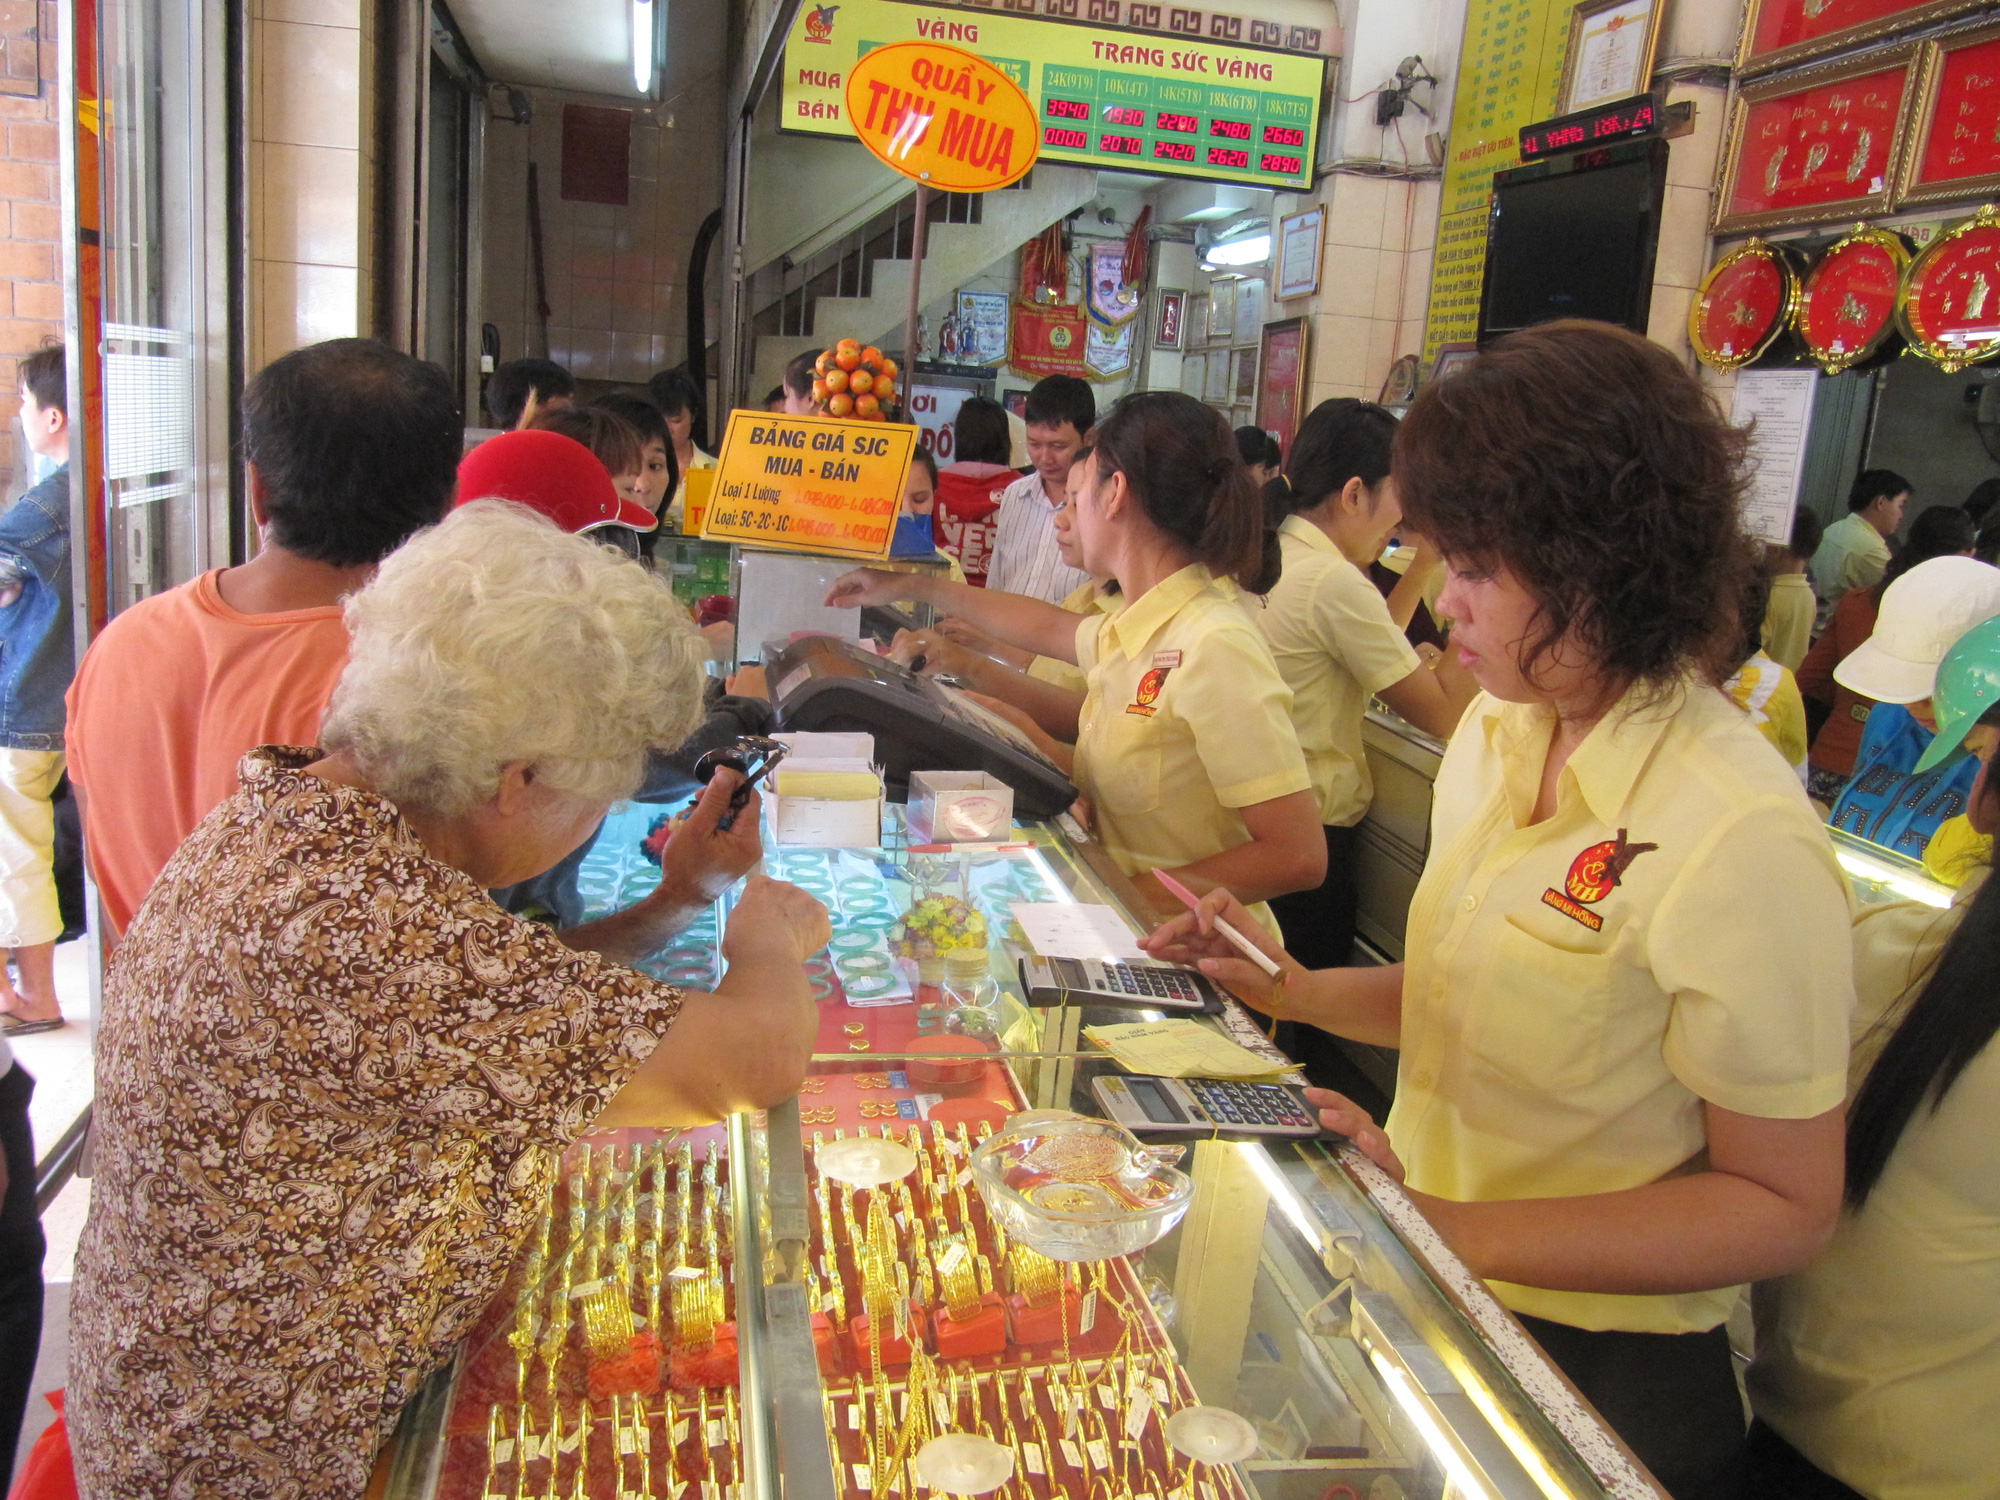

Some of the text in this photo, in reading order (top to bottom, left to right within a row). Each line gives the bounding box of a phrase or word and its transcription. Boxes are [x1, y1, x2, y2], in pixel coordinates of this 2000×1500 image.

[917, 16, 978, 43] VÀNG
[1092, 40, 1273, 82] TRANG SỨC VÀNG
[799, 69, 841, 89] MUA
[911, 58, 996, 106] QUẦY
[1047, 71, 1094, 91] 24K(9T9)
[1104, 78, 1149, 98] 10K(4T)
[1265, 98, 1309, 119] 18K(7T5)
[798, 101, 840, 120] BÁN
[863, 79, 1015, 177] THU MUA
[1047, 99, 1089, 120] 3940
[1105, 106, 1145, 127] 1930
[1210, 119, 1252, 140] 2480
[1263, 126, 1304, 147] 2660
[1044, 128, 1087, 149] 0000
[1100, 134, 1143, 155] 2070
[1154, 141, 1196, 161] 2420
[1207, 147, 1249, 168] 2620
[749, 421, 889, 456] BẢNG GIÁ SJC
[764, 456, 803, 477] MUA
[820, 457, 860, 483] BÁN
[721, 480, 782, 505] Loại 1 Lượng
[714, 508, 738, 532] Loại:
